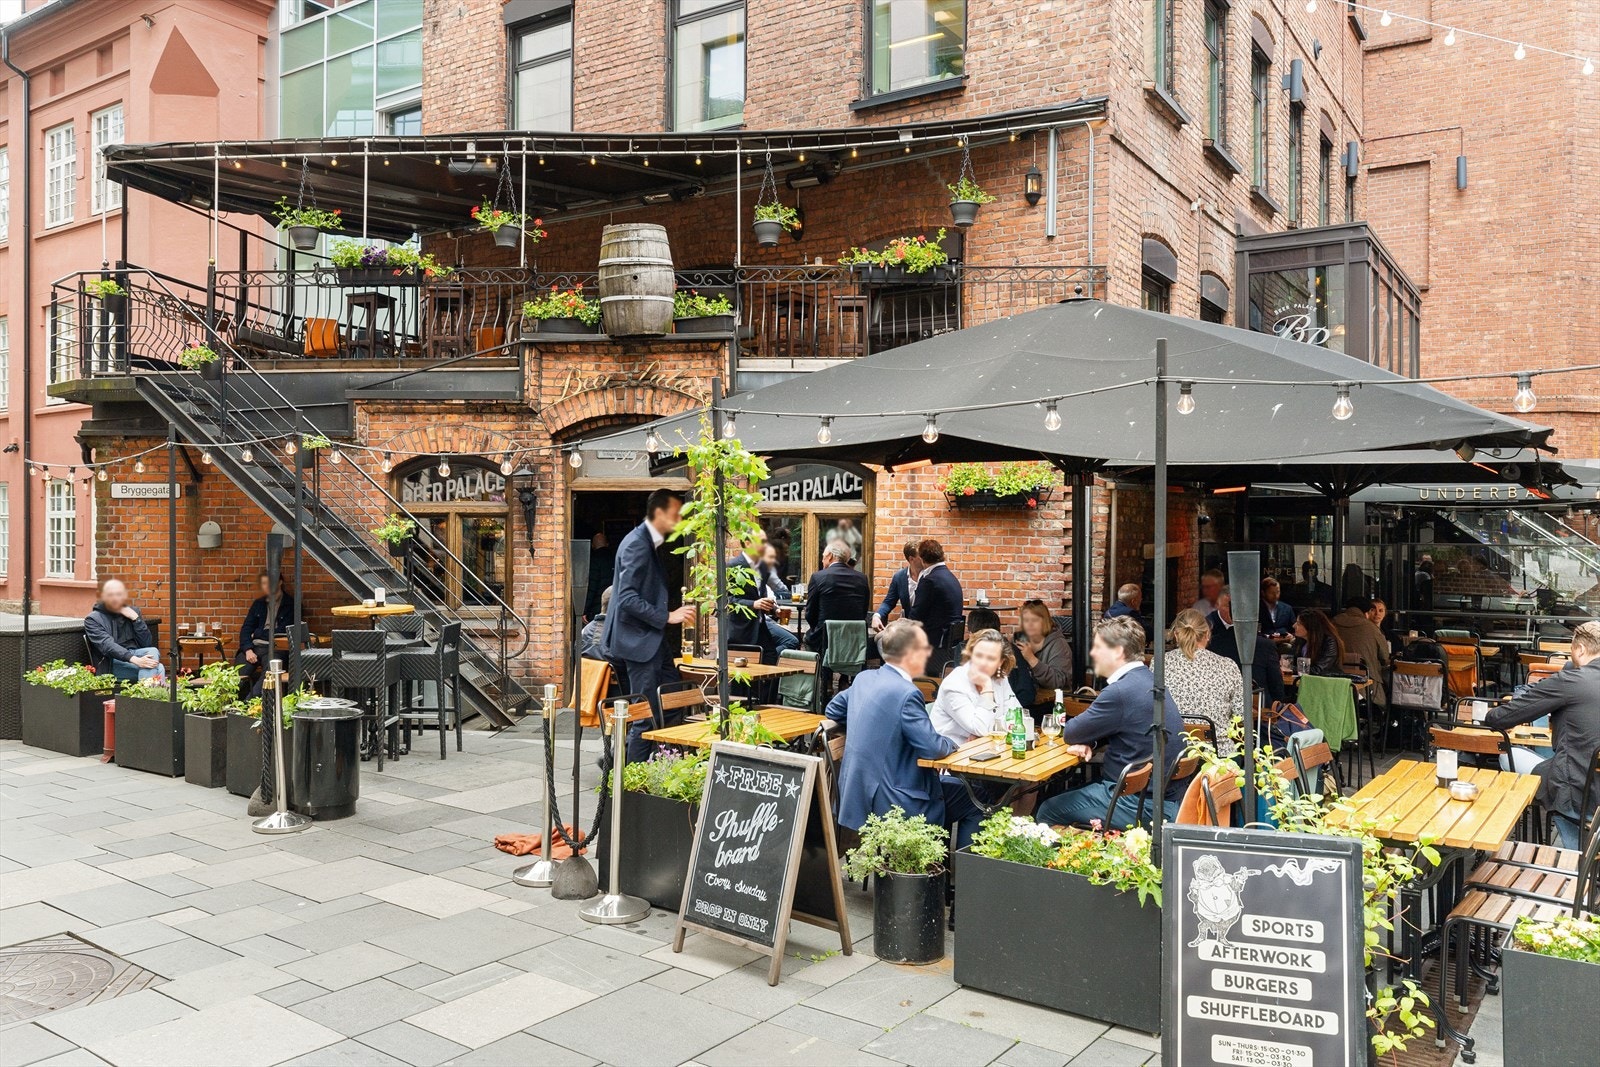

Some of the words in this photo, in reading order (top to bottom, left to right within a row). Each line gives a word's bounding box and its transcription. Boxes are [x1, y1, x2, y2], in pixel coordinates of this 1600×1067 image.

[1274, 305, 1290, 315] BEER
[1294, 303, 1317, 312] PALACE
[759, 482, 799, 501] BEER
[1419, 487, 1536, 500] UNDERBA
[727, 766, 783, 797] FREE
[709, 802, 784, 842] Shuffle-
[714, 833, 764, 868] board
[704, 872, 731, 890] Every
[734, 880, 767, 902] Sunday
[695, 899, 722, 918] DROP
[723, 908, 737, 923] IN
[738, 913, 769, 932] ONLY
[1252, 919, 1314, 938] SPORTS
[1211, 944, 1313, 968] AFTERWORK
[1224, 974, 1298, 995] BURGERS
[1200, 1001, 1325, 1028] SHUFFLEBOARD
